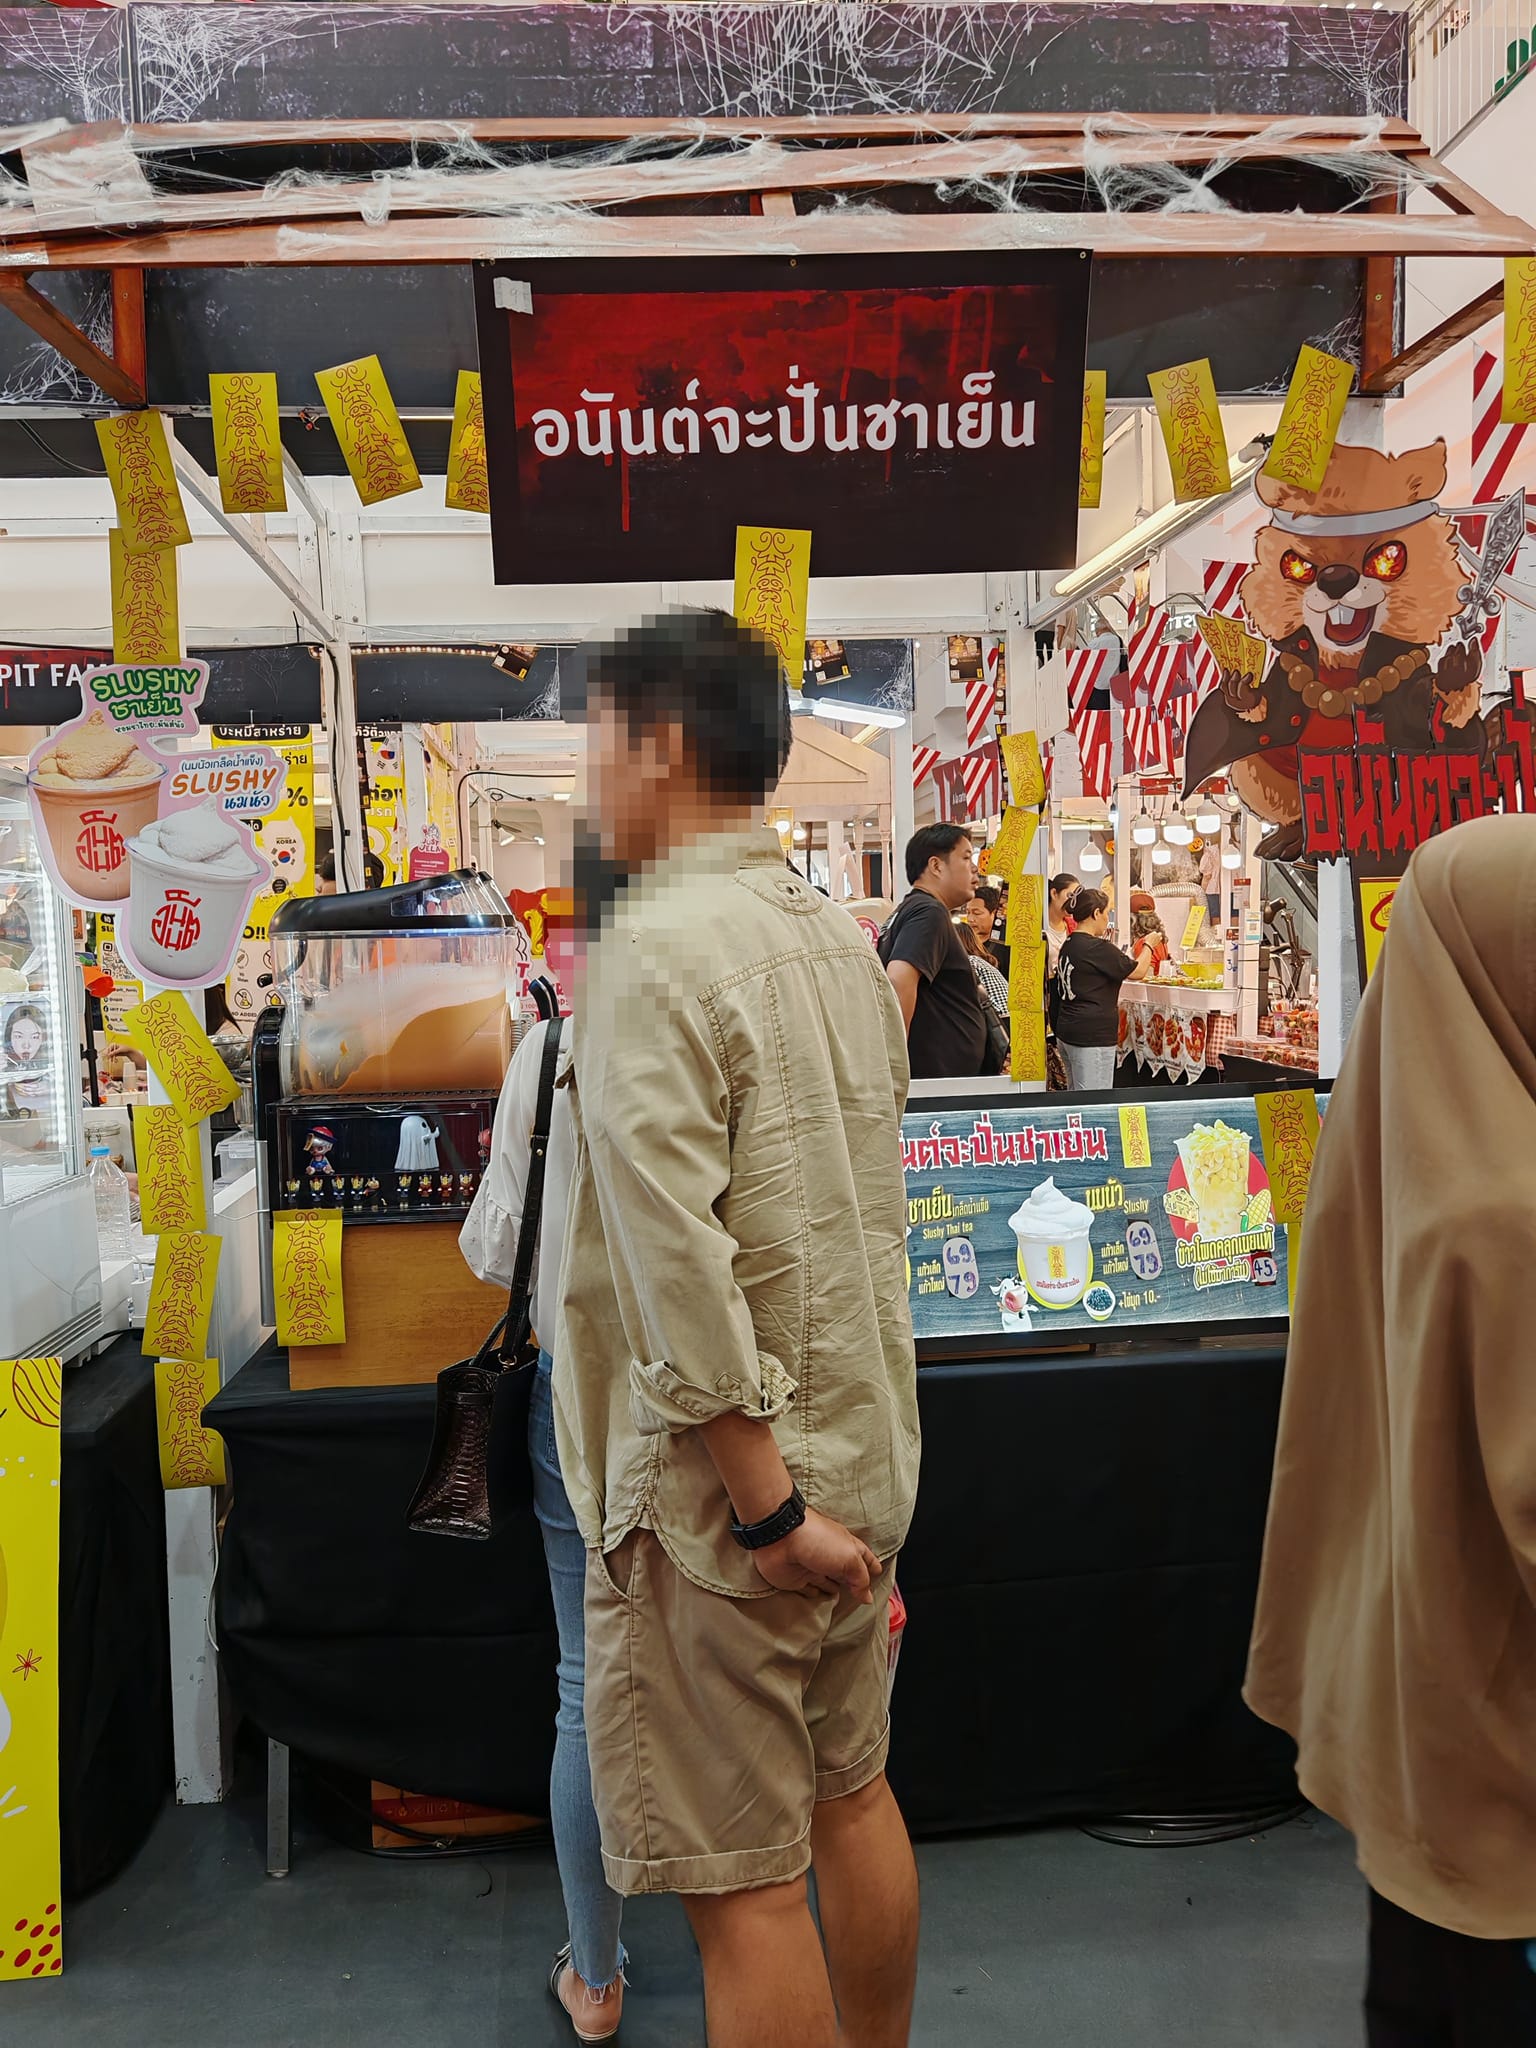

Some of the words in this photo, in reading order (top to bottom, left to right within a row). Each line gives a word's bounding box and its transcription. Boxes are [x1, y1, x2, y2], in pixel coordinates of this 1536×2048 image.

[532, 365, 1036, 456] อนันต์จะปั่นชาเย็น
[50, 664, 108, 687] FA
[90, 667, 201, 702] SLUSHY
[109, 692, 184, 721] ชาเย็น
[171, 767, 277, 797] SLUSHY
[223, 789, 271, 810] นมนัว
[908, 1185, 953, 1225] ชาเย็น
[1122, 1199, 1150, 1216] Slushy
[922, 1226, 945, 1241] Slushy
[946, 1222, 961, 1236] Thai
[961, 1221, 974, 1233] tea
[1177, 1226, 1274, 1265] ข้าวโพดคลุกเนยแท้
[947, 1271, 977, 1295] 79
